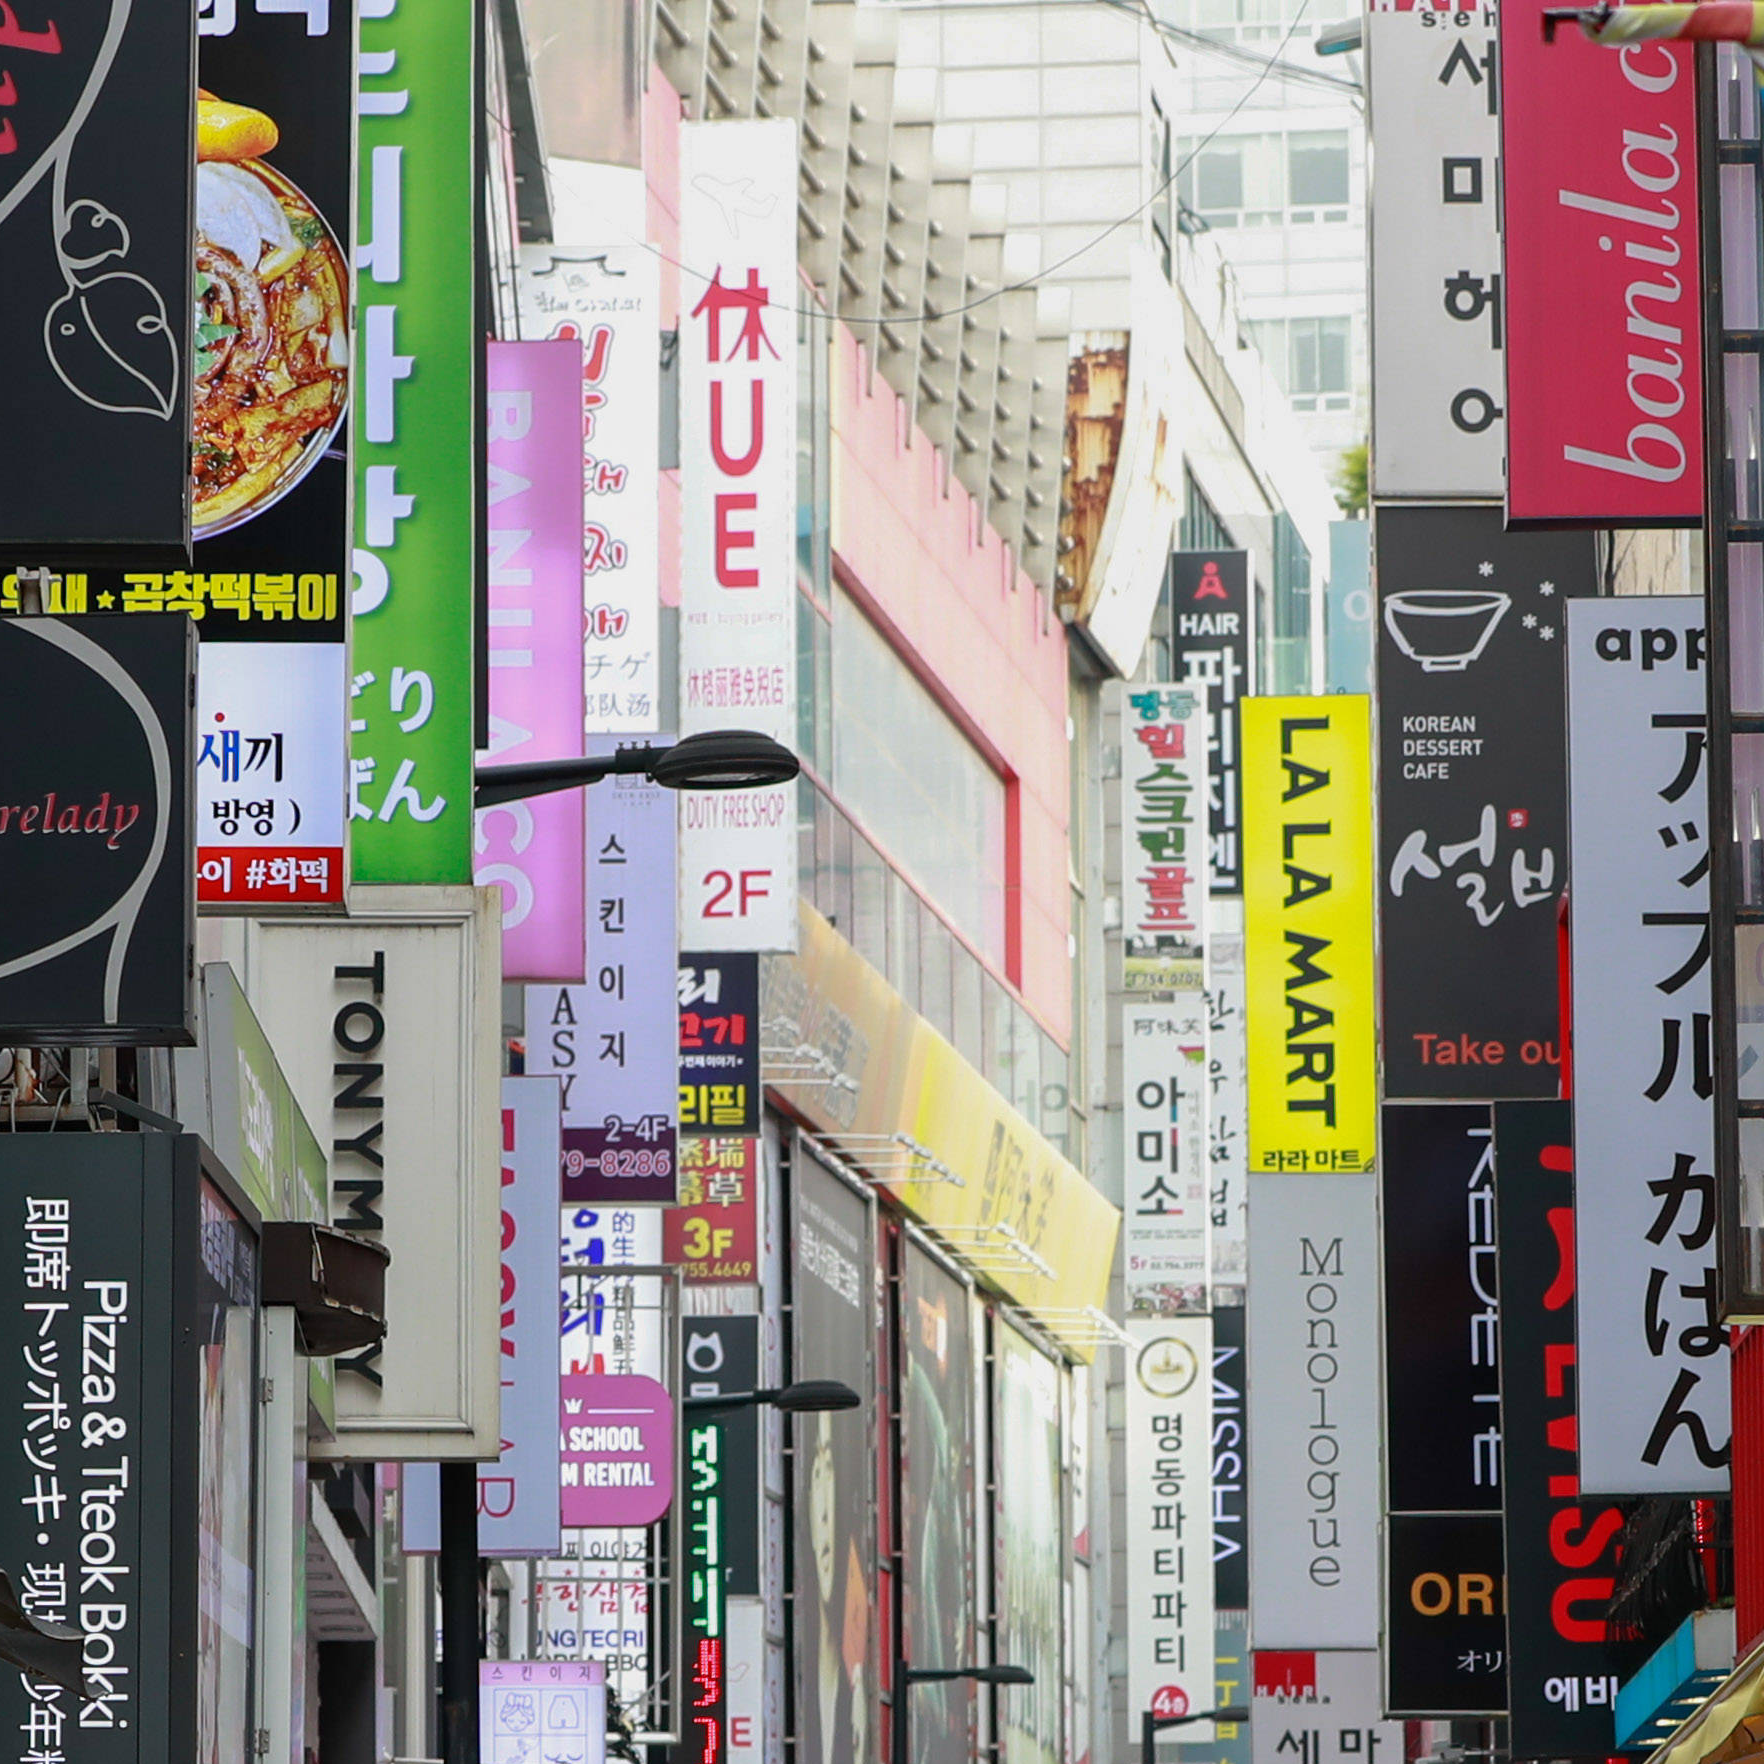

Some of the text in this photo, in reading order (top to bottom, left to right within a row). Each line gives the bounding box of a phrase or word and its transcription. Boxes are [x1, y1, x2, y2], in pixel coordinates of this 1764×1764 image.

[1559, 123, 1686, 483] banila
[121, 570, 338, 622] 곱창떡볶이
[1180, 613, 1240, 637] HAIR
[1402, 716, 1476, 734] KOREAN
[1402, 738, 1484, 757] DESSERT
[1402, 762, 1450, 781] CAFE
[686, 795, 785, 829] DUTY FREE SHOP
[245, 855, 329, 894] #화떡
[701, 869, 773, 918] 2F
[1280, 715, 1337, 1130] LA LA MART
[597, 831, 628, 1069] 스킨이지
[1413, 1033, 1505, 1066] Take
[604, 1115, 670, 1144] 2-4F
[1136, 1076, 1187, 1217] 아미소
[332, 950, 386, 1390] TONYMY
[1262, 1149, 1363, 1171] 라라 마트
[682, 1216, 735, 1261] 3F
[82, 1279, 129, 1405] Pizza
[1298, 1237, 1344, 1588] Monologue
[569, 1426, 644, 1452] SCHOOL
[583, 1461, 655, 1488] RENTAL
[80, 1455, 129, 1594] Tteok
[1410, 1573, 1507, 1617] OR
[78, 1603, 130, 1729] Bokki
